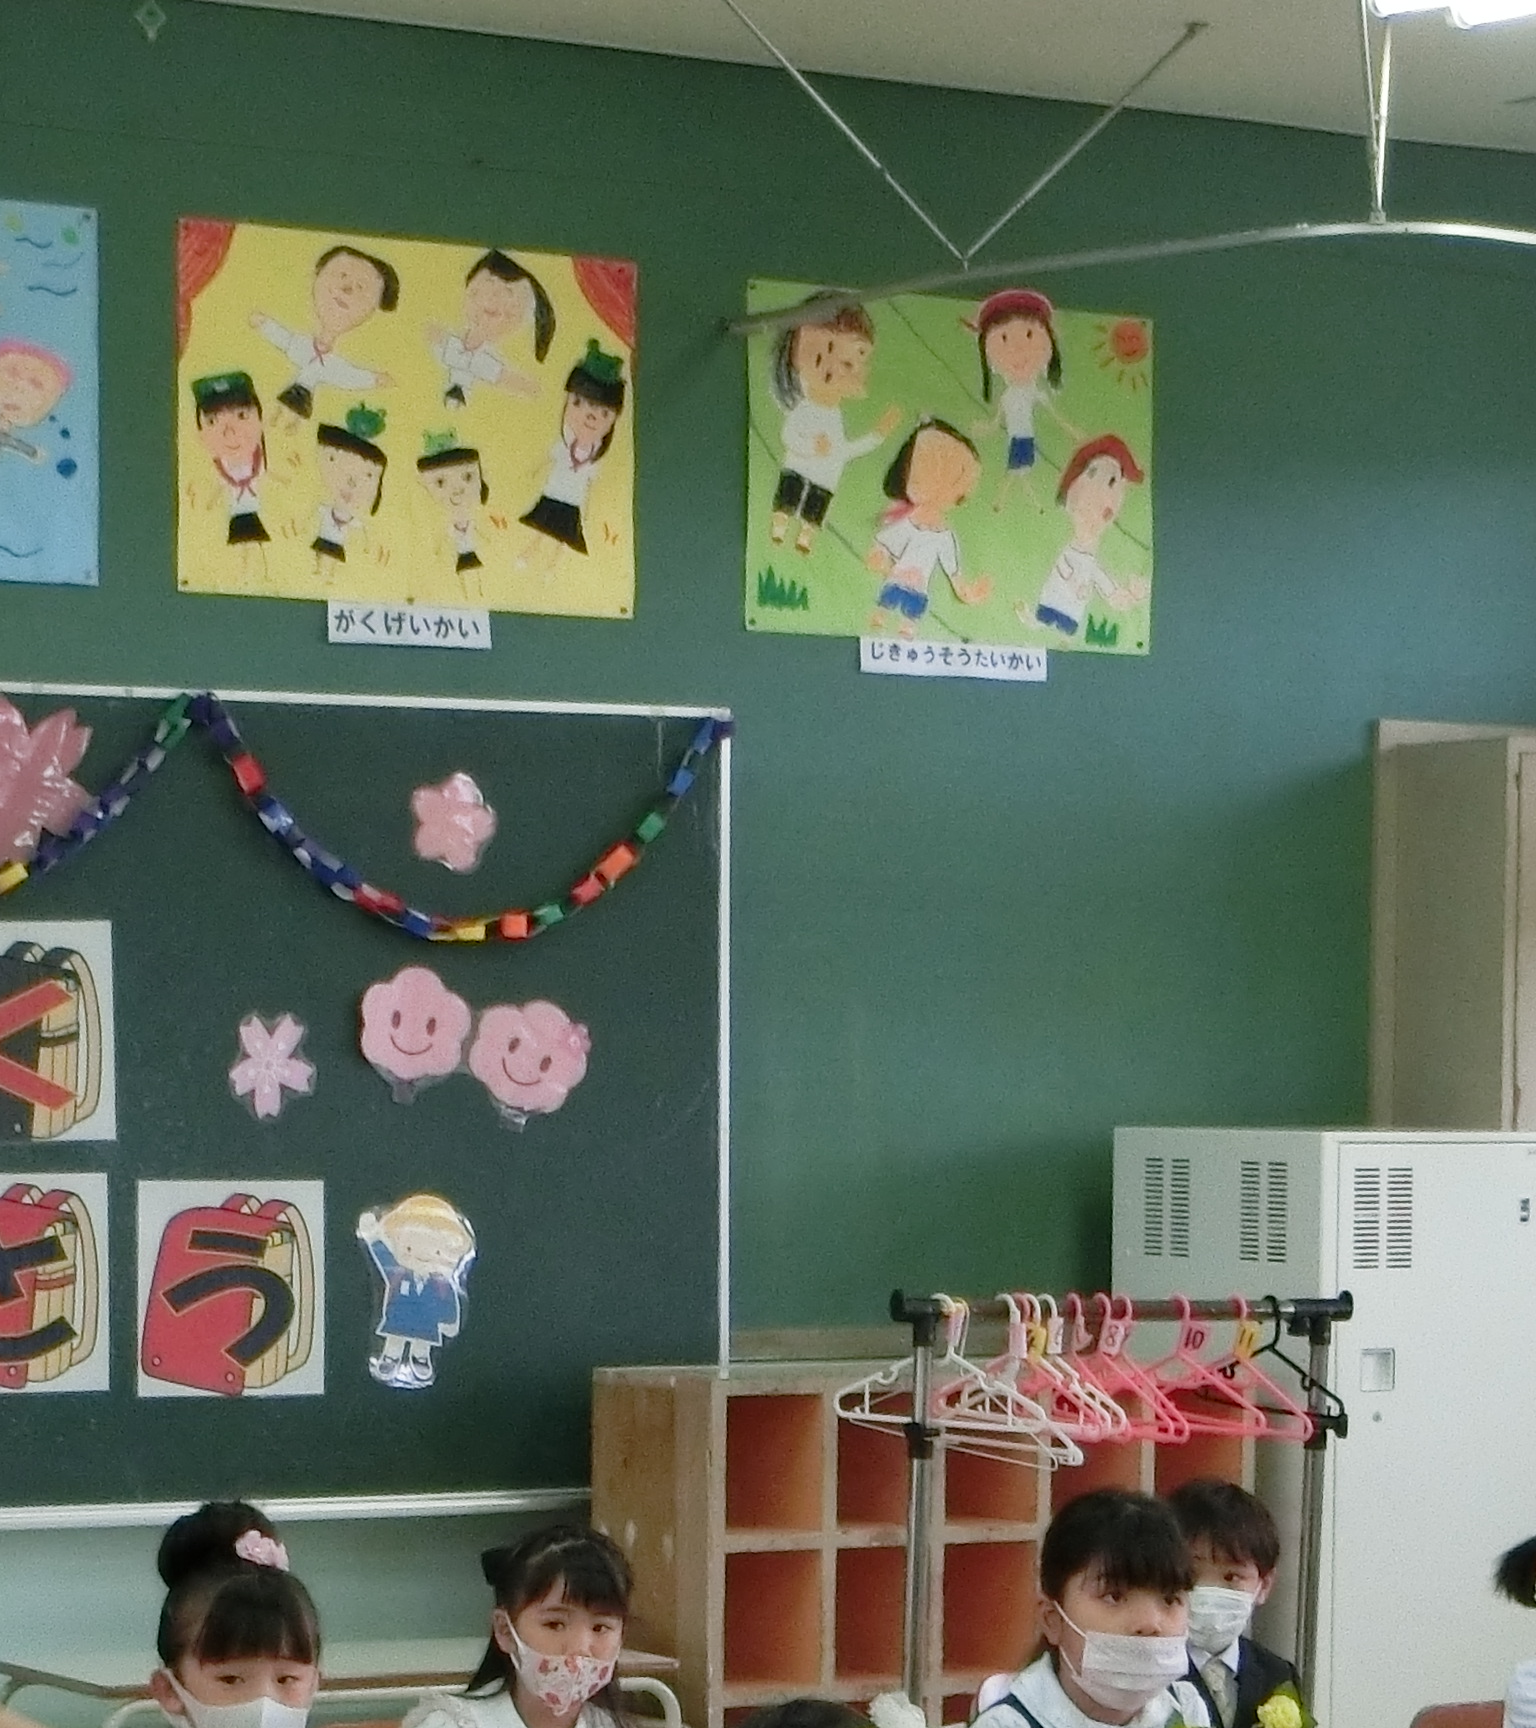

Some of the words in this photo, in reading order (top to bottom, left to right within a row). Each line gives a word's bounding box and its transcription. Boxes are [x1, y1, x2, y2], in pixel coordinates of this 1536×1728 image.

[334, 609, 480, 639] がくげいかい
[870, 640, 1043, 671] じきゅうそうたいかい
[1184, 1327, 1205, 1350] 10
